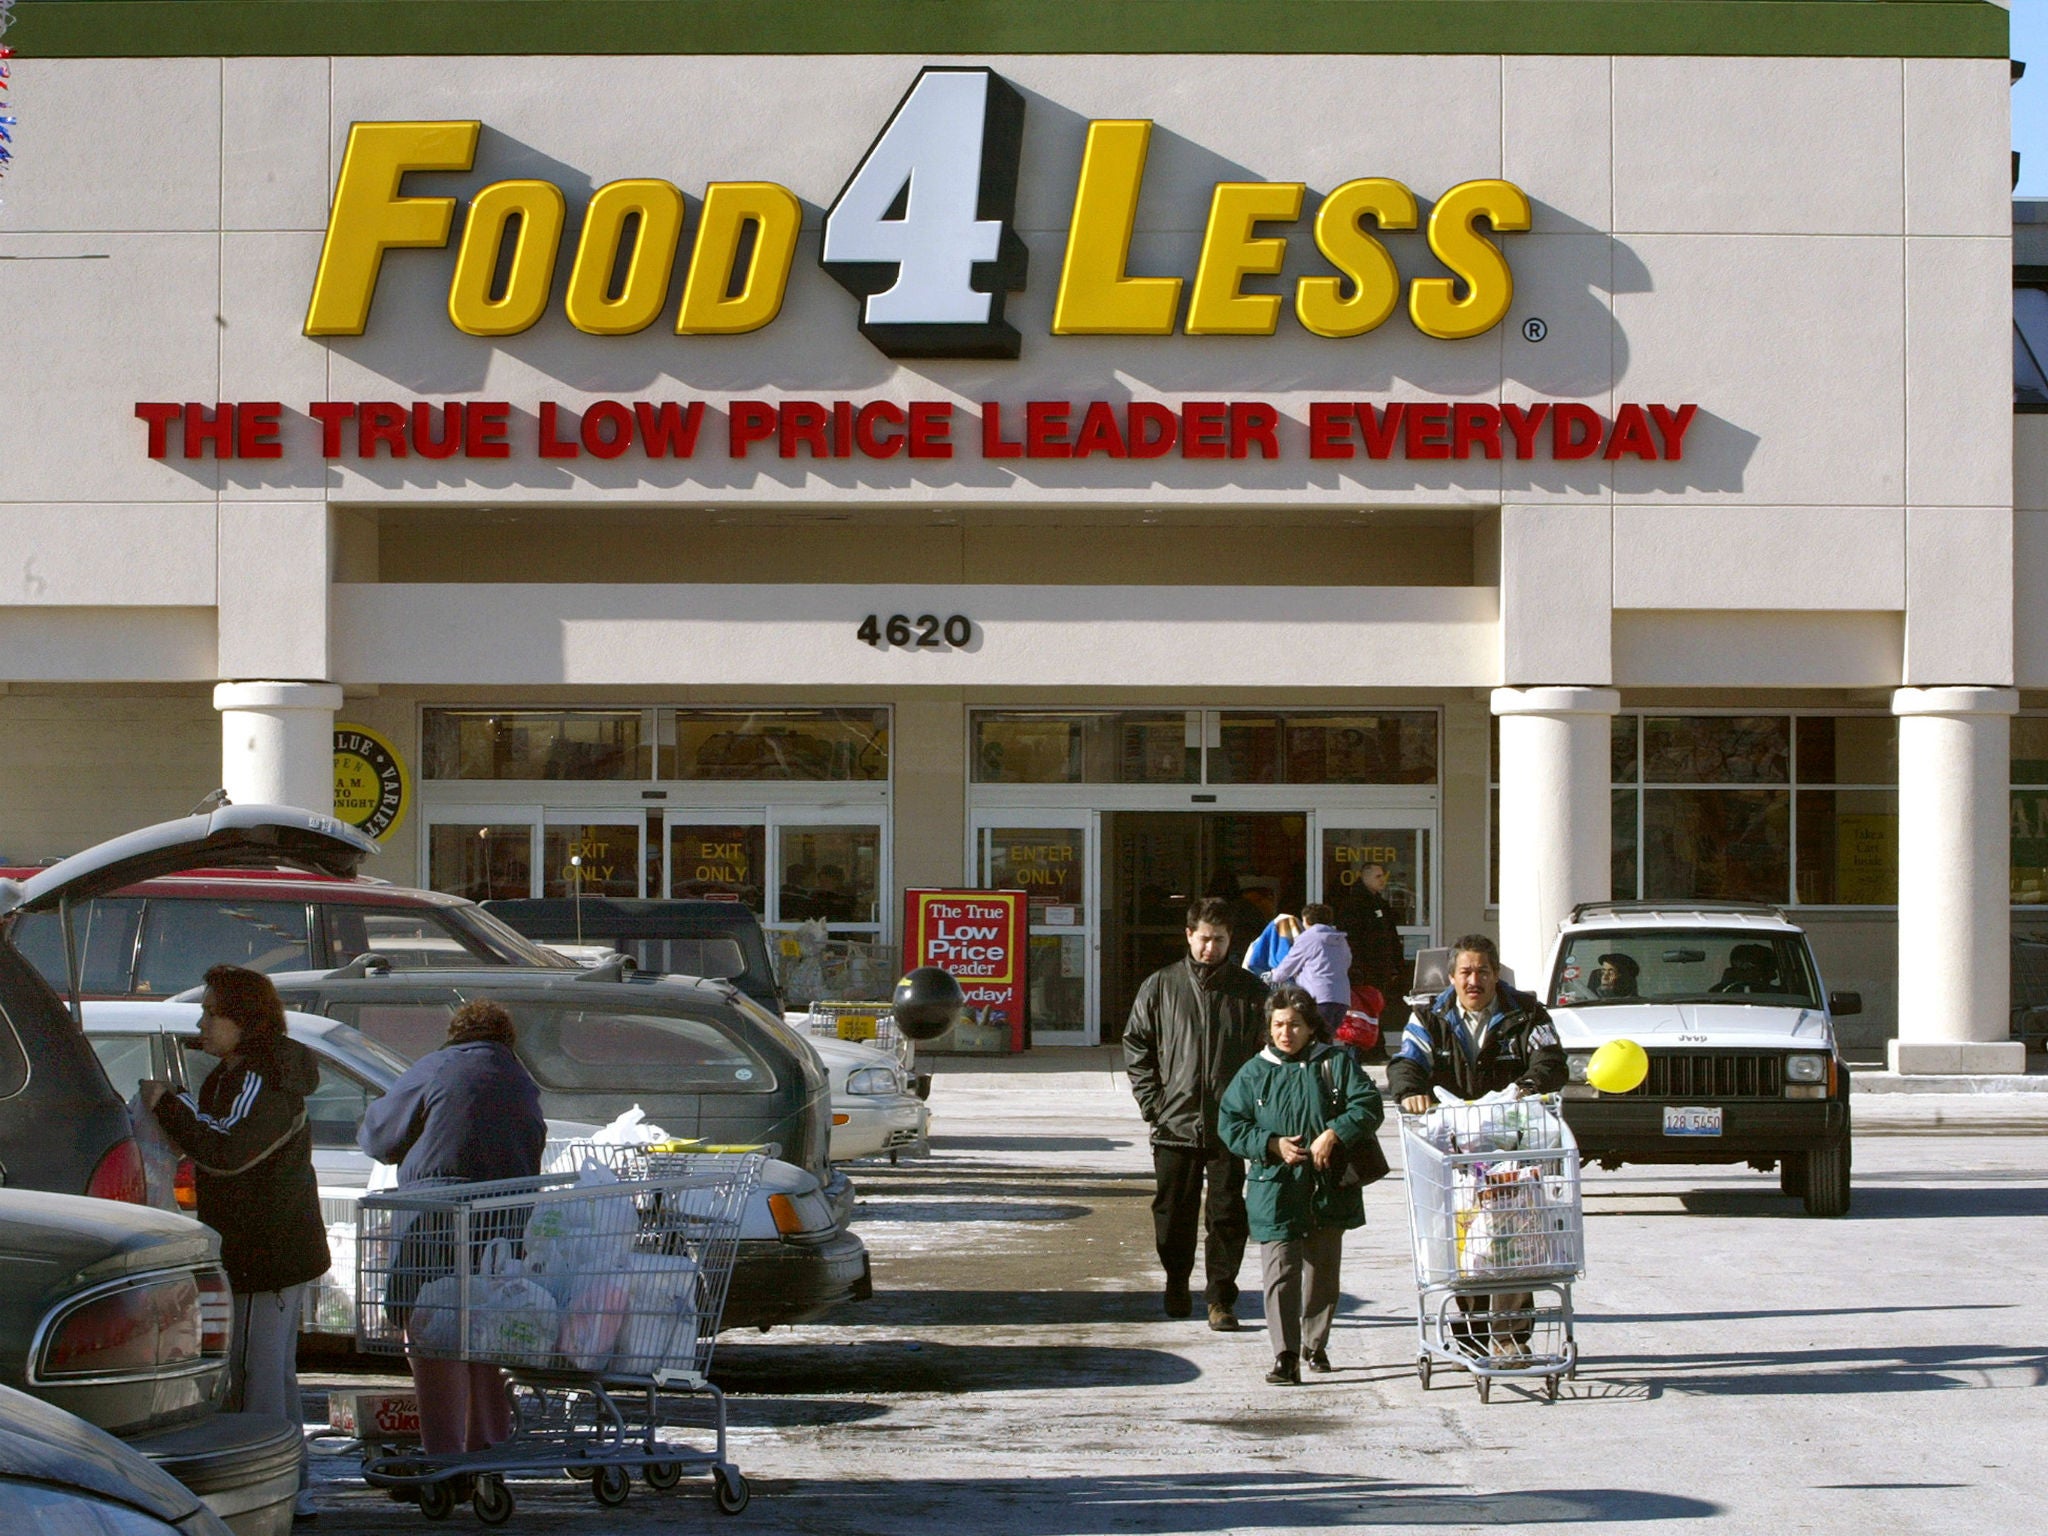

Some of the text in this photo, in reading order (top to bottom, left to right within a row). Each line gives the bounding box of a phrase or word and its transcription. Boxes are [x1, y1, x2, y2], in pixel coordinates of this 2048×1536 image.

[820, 65, 1016, 348] 4
[135, 401, 1697, 461] THE TRUE LOW PRICE LEADER EVERYDAY
[856, 614, 972, 648] 4620
[335, 788, 352, 798] TO
[365, 765, 401, 839] VARIET
[568, 842, 610, 859] EXIT
[701, 842, 743, 859] EXIT
[1011, 845, 1073, 861] ENTER
[1335, 846, 1397, 862] ENTER
[562, 865, 614, 882] ONLY
[695, 866, 748, 883] ONLY
[1016, 868, 1069, 885] ONLY
[929, 903, 1004, 919] The True
[937, 919, 999, 940] Low
[927, 939, 1005, 961] Price
[936, 960, 995, 975] Leader
[961, 987, 1013, 1004] yday!
[1666, 1115, 1686, 1130] 128
